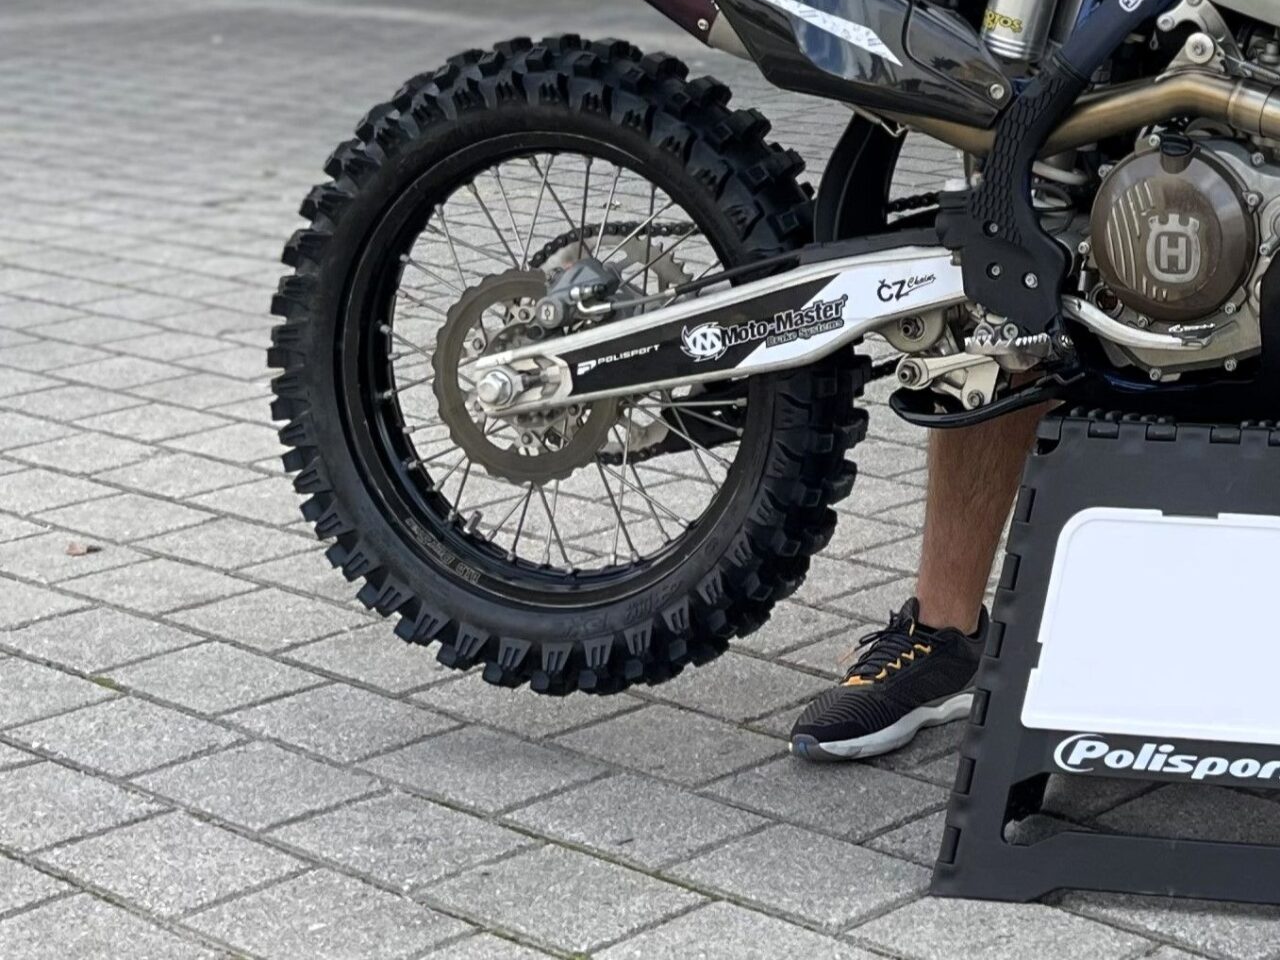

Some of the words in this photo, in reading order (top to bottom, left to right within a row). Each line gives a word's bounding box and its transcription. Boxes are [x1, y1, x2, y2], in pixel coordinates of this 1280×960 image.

[877, 278, 906, 302] ČZ
[721, 295, 846, 348] Moto-Master
[597, 344, 660, 365] POLISPORT
